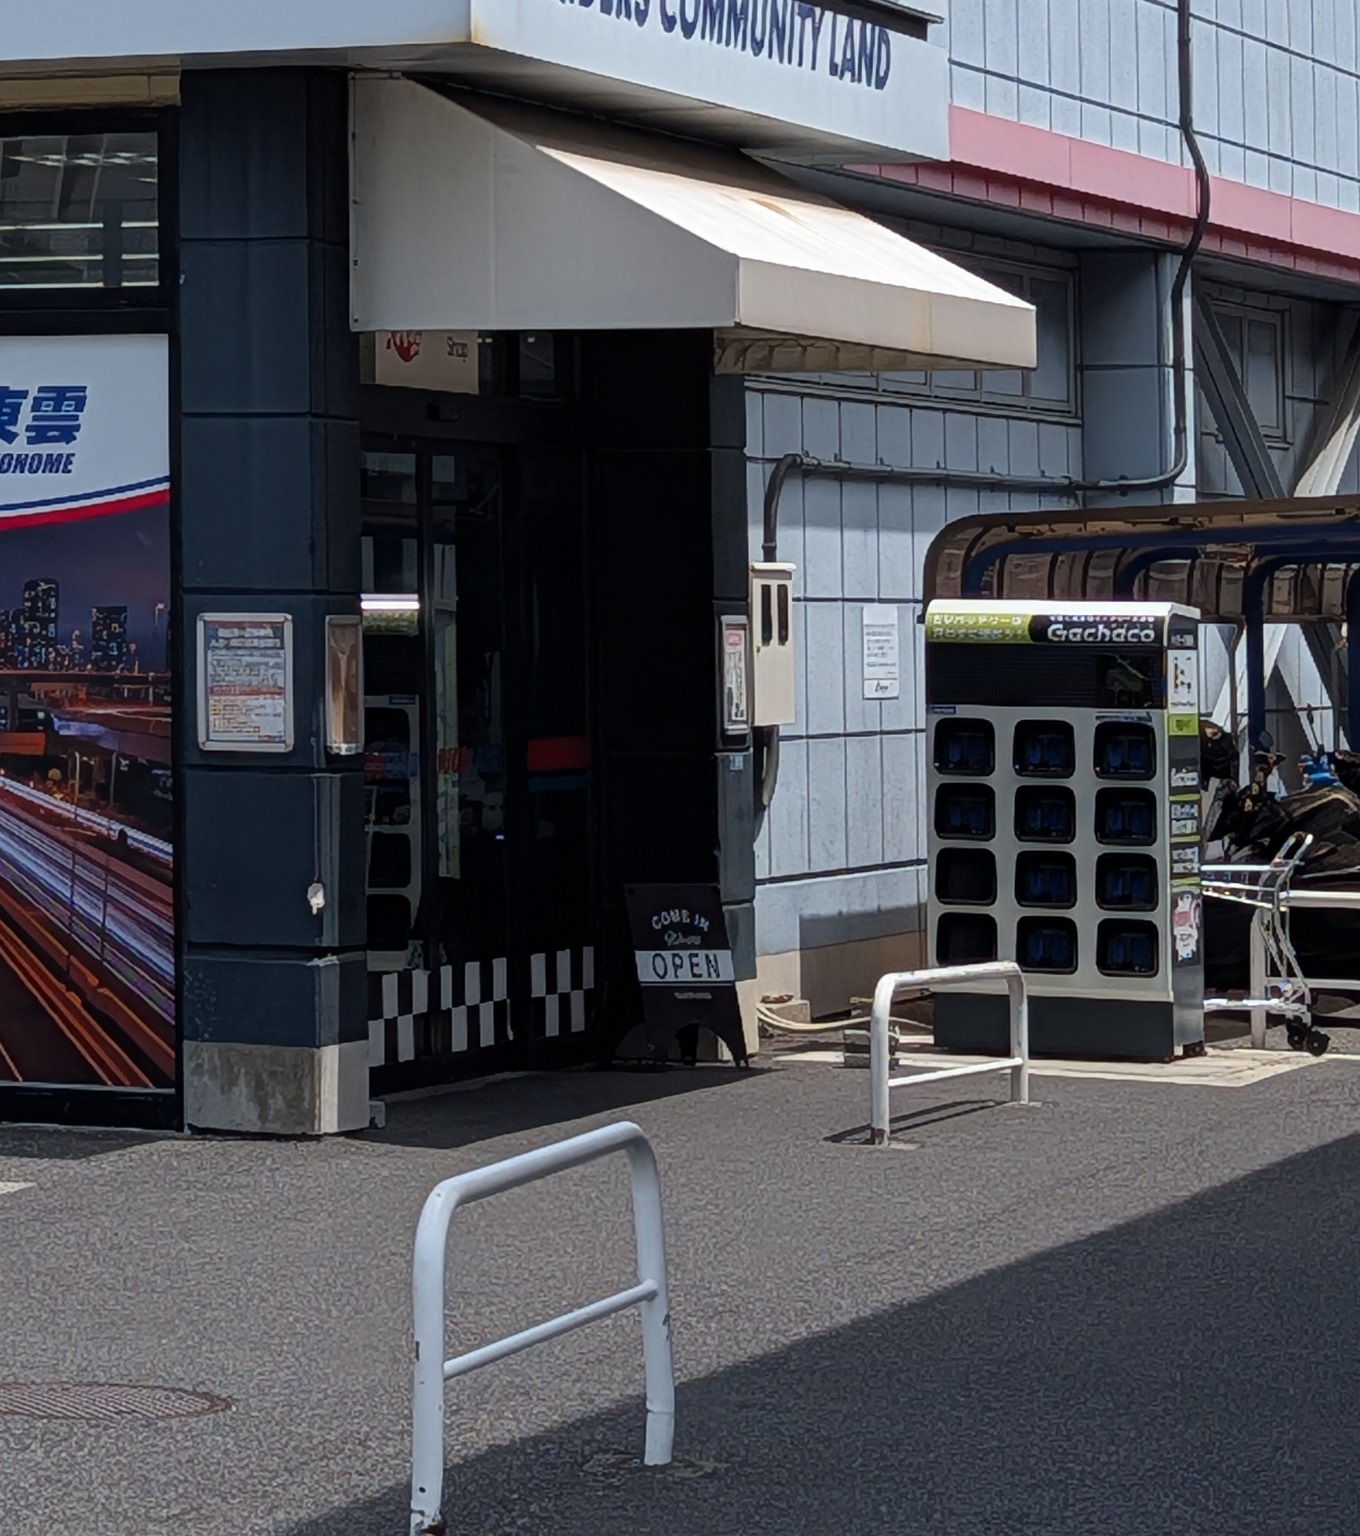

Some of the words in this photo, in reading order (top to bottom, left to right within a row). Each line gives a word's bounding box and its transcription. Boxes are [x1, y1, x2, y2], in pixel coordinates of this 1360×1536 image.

[829, 9, 892, 91] LAND
[1047, 623, 1156, 642] Gachaco
[651, 952, 721, 980] OPEN
